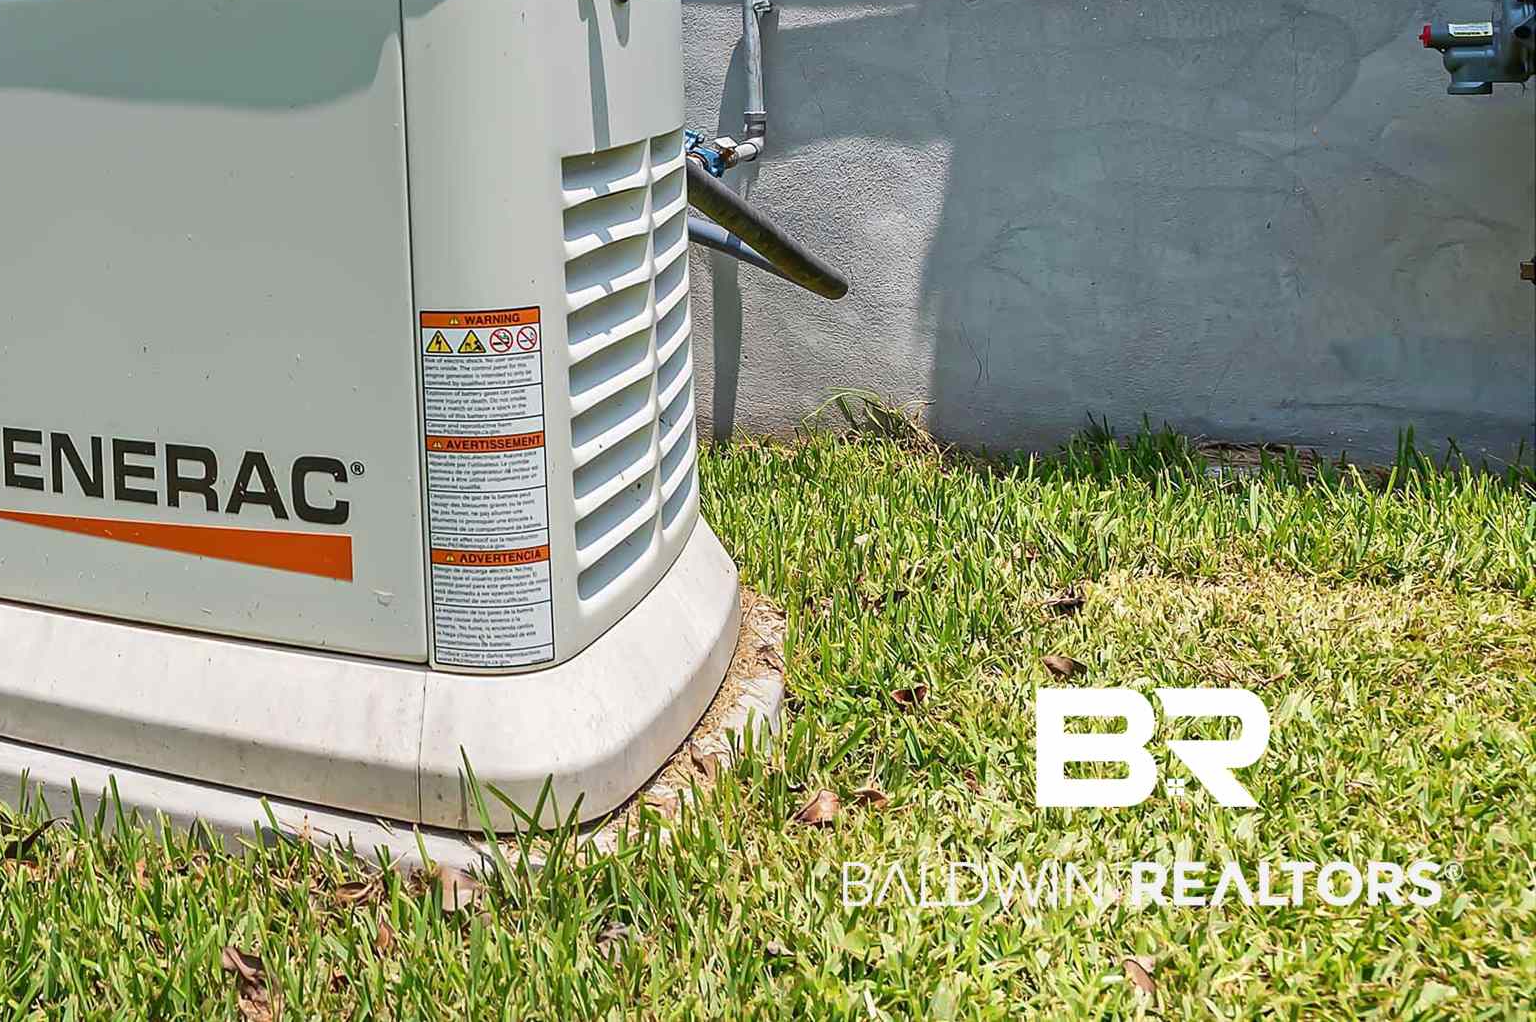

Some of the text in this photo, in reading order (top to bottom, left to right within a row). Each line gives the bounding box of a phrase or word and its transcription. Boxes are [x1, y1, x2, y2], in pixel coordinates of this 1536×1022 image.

[465, 313, 521, 325] WARNING
[447, 435, 541, 449] AVERTISSEMENT
[460, 550, 541, 563] ADVERTENCIA
